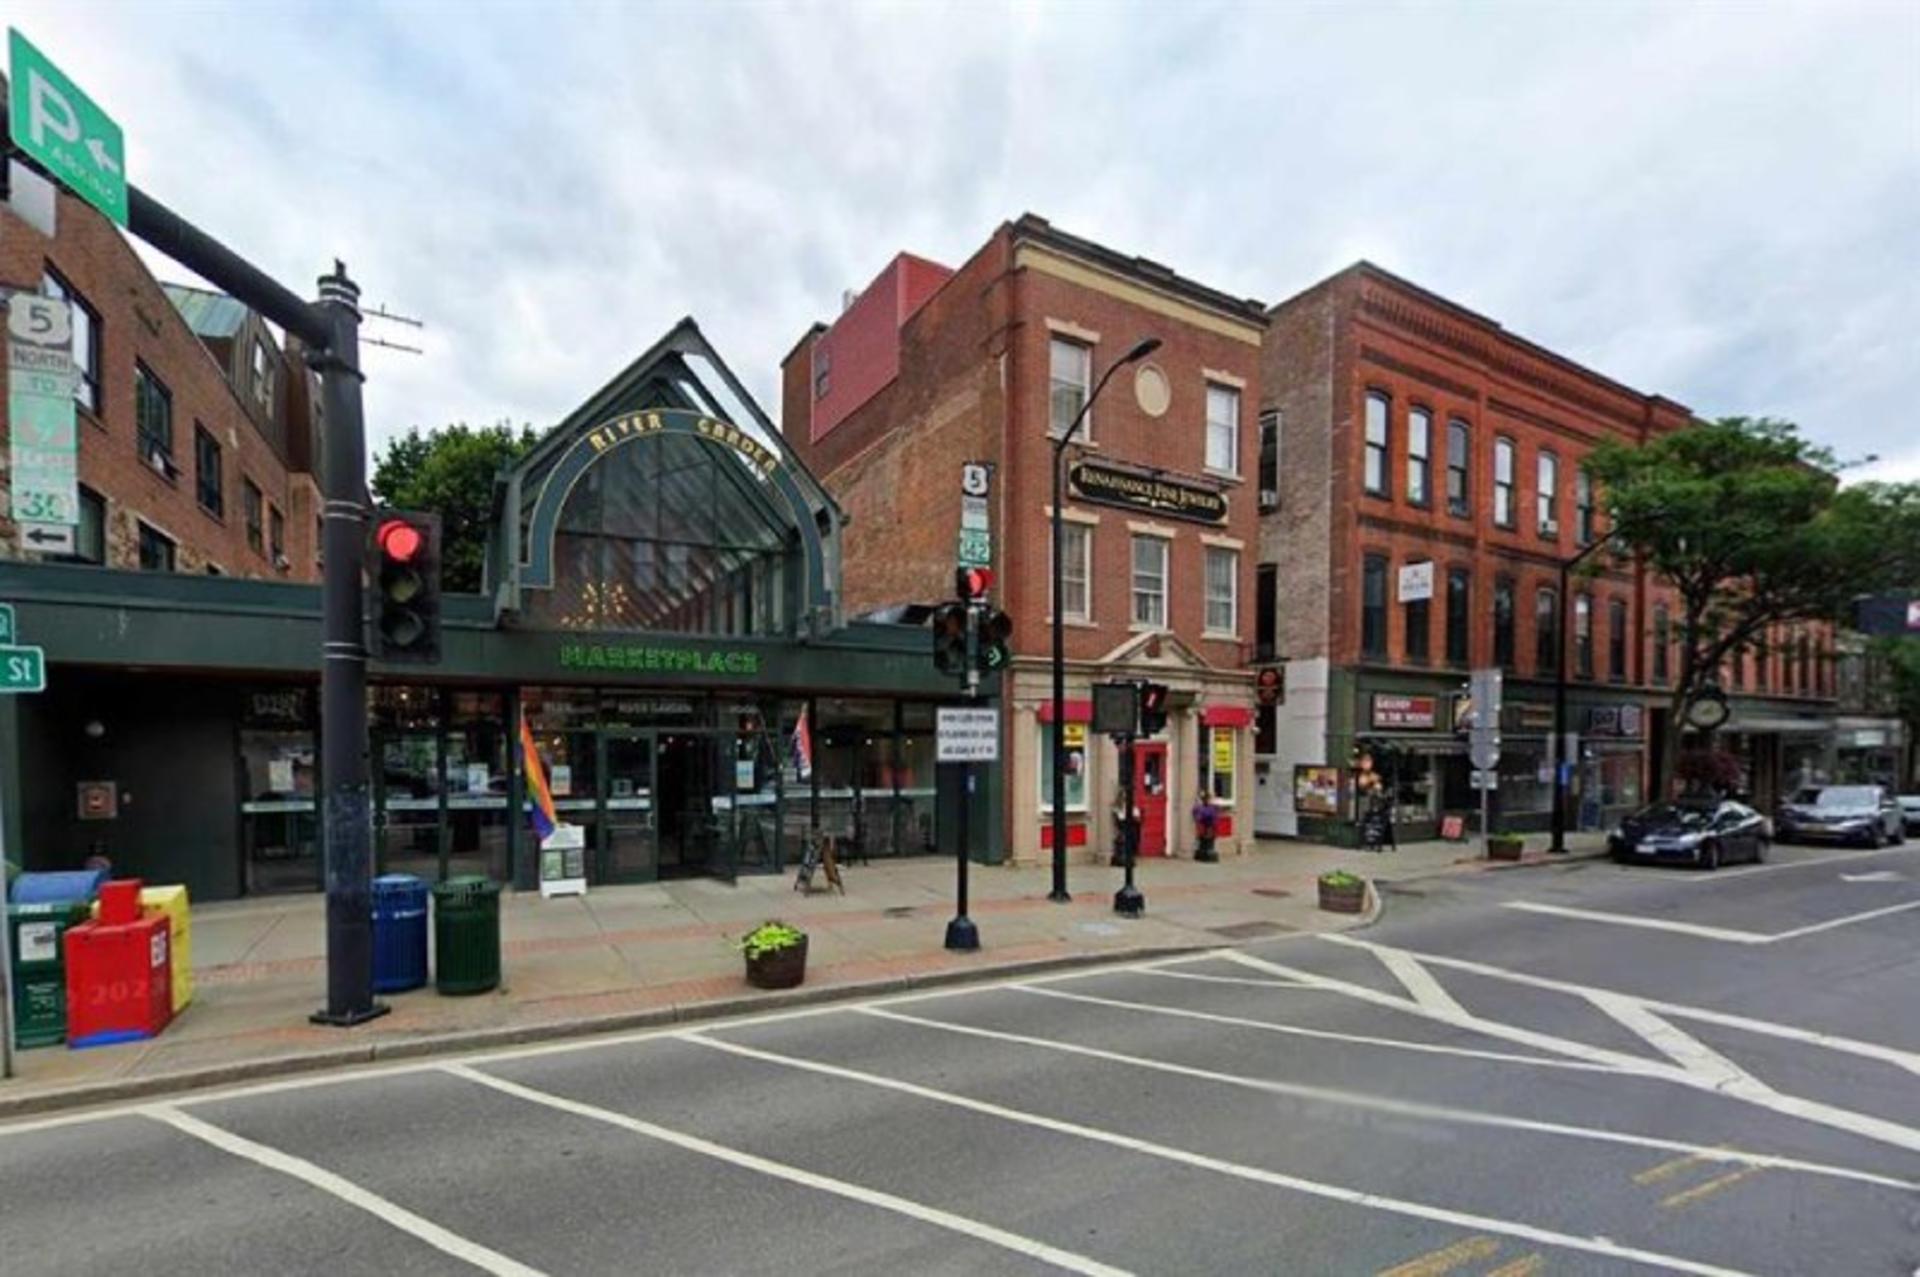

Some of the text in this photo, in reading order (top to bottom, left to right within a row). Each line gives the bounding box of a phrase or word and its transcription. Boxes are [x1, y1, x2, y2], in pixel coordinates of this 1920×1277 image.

[28, 67, 82, 148] P
[29, 304, 53, 333] 5
[14, 346, 69, 370] NORTH
[589, 413, 662, 451] RIVER
[970, 470, 981, 489] 5
[8, 656, 32, 682] St
[560, 646, 758, 674] MARKETPLACE
